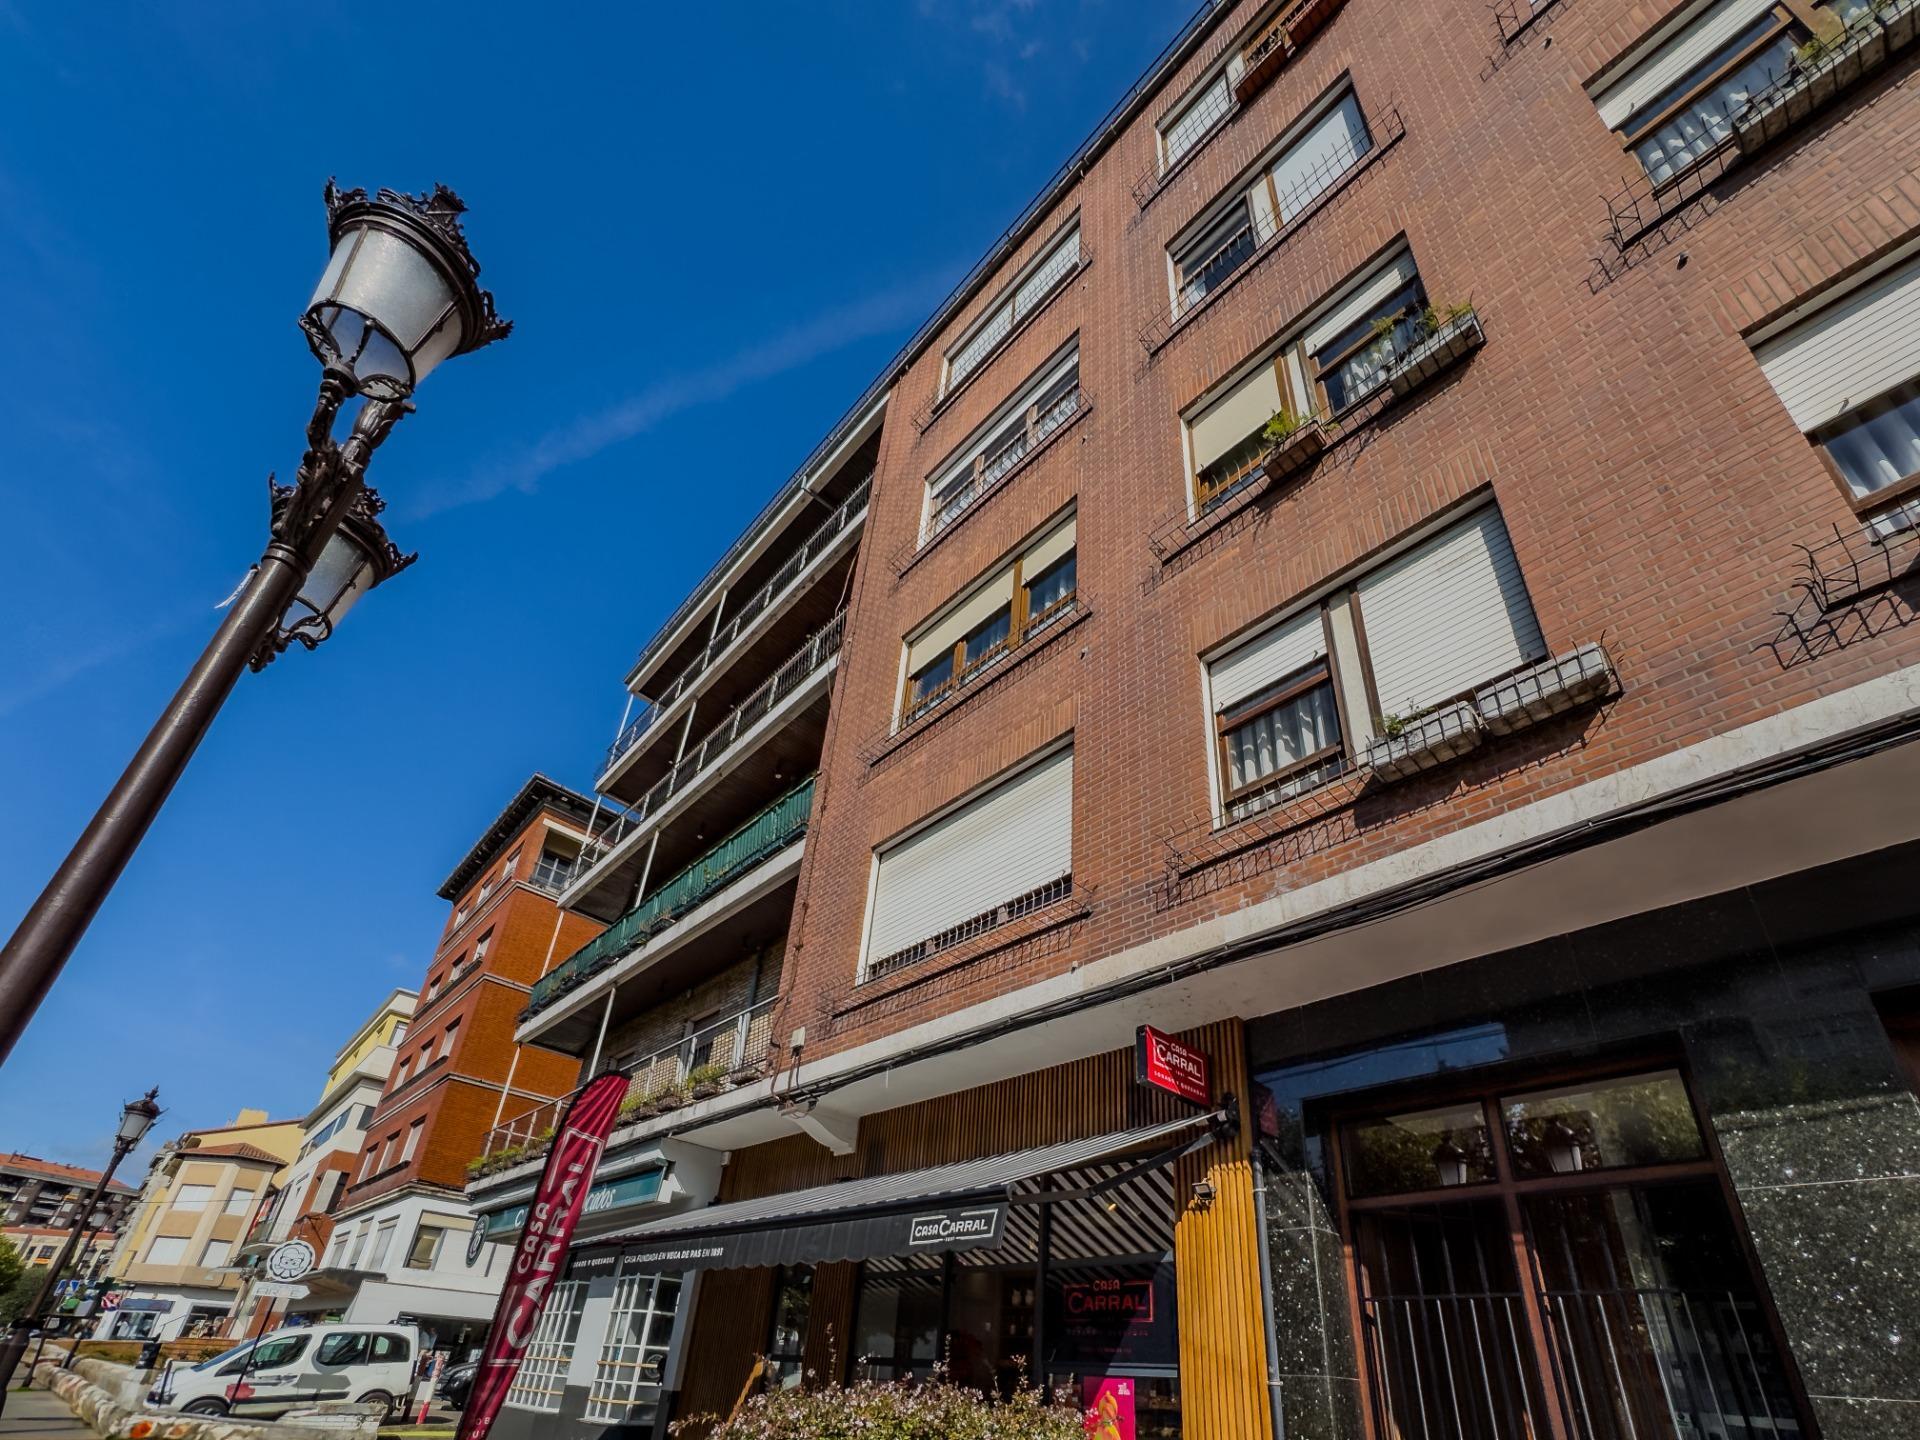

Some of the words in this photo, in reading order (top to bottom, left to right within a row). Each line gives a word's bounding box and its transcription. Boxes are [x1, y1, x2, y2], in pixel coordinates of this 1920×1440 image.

[1171, 1043, 1187, 1057] CASA
[1156, 1044, 1201, 1077] CARRAL
[914, 1224, 939, 1237] CASA
[939, 1218, 988, 1236] CARRAL
[515, 1201, 550, 1275] CASA
[506, 1149, 592, 1349] CARRAL
[624, 1255, 636, 1264] CASA
[636, 1253, 658, 1263] FUNDADA
[658, 1251, 666, 1260] EN
[666, 1251, 680, 1260] VEGA
[681, 1250, 690, 1259] DE
[690, 1249, 701, 1258] PAS
[702, 1248, 710, 1257] EN
[1092, 1279, 1121, 1291] CASA
[1068, 1291, 1147, 1313] CARRAL
